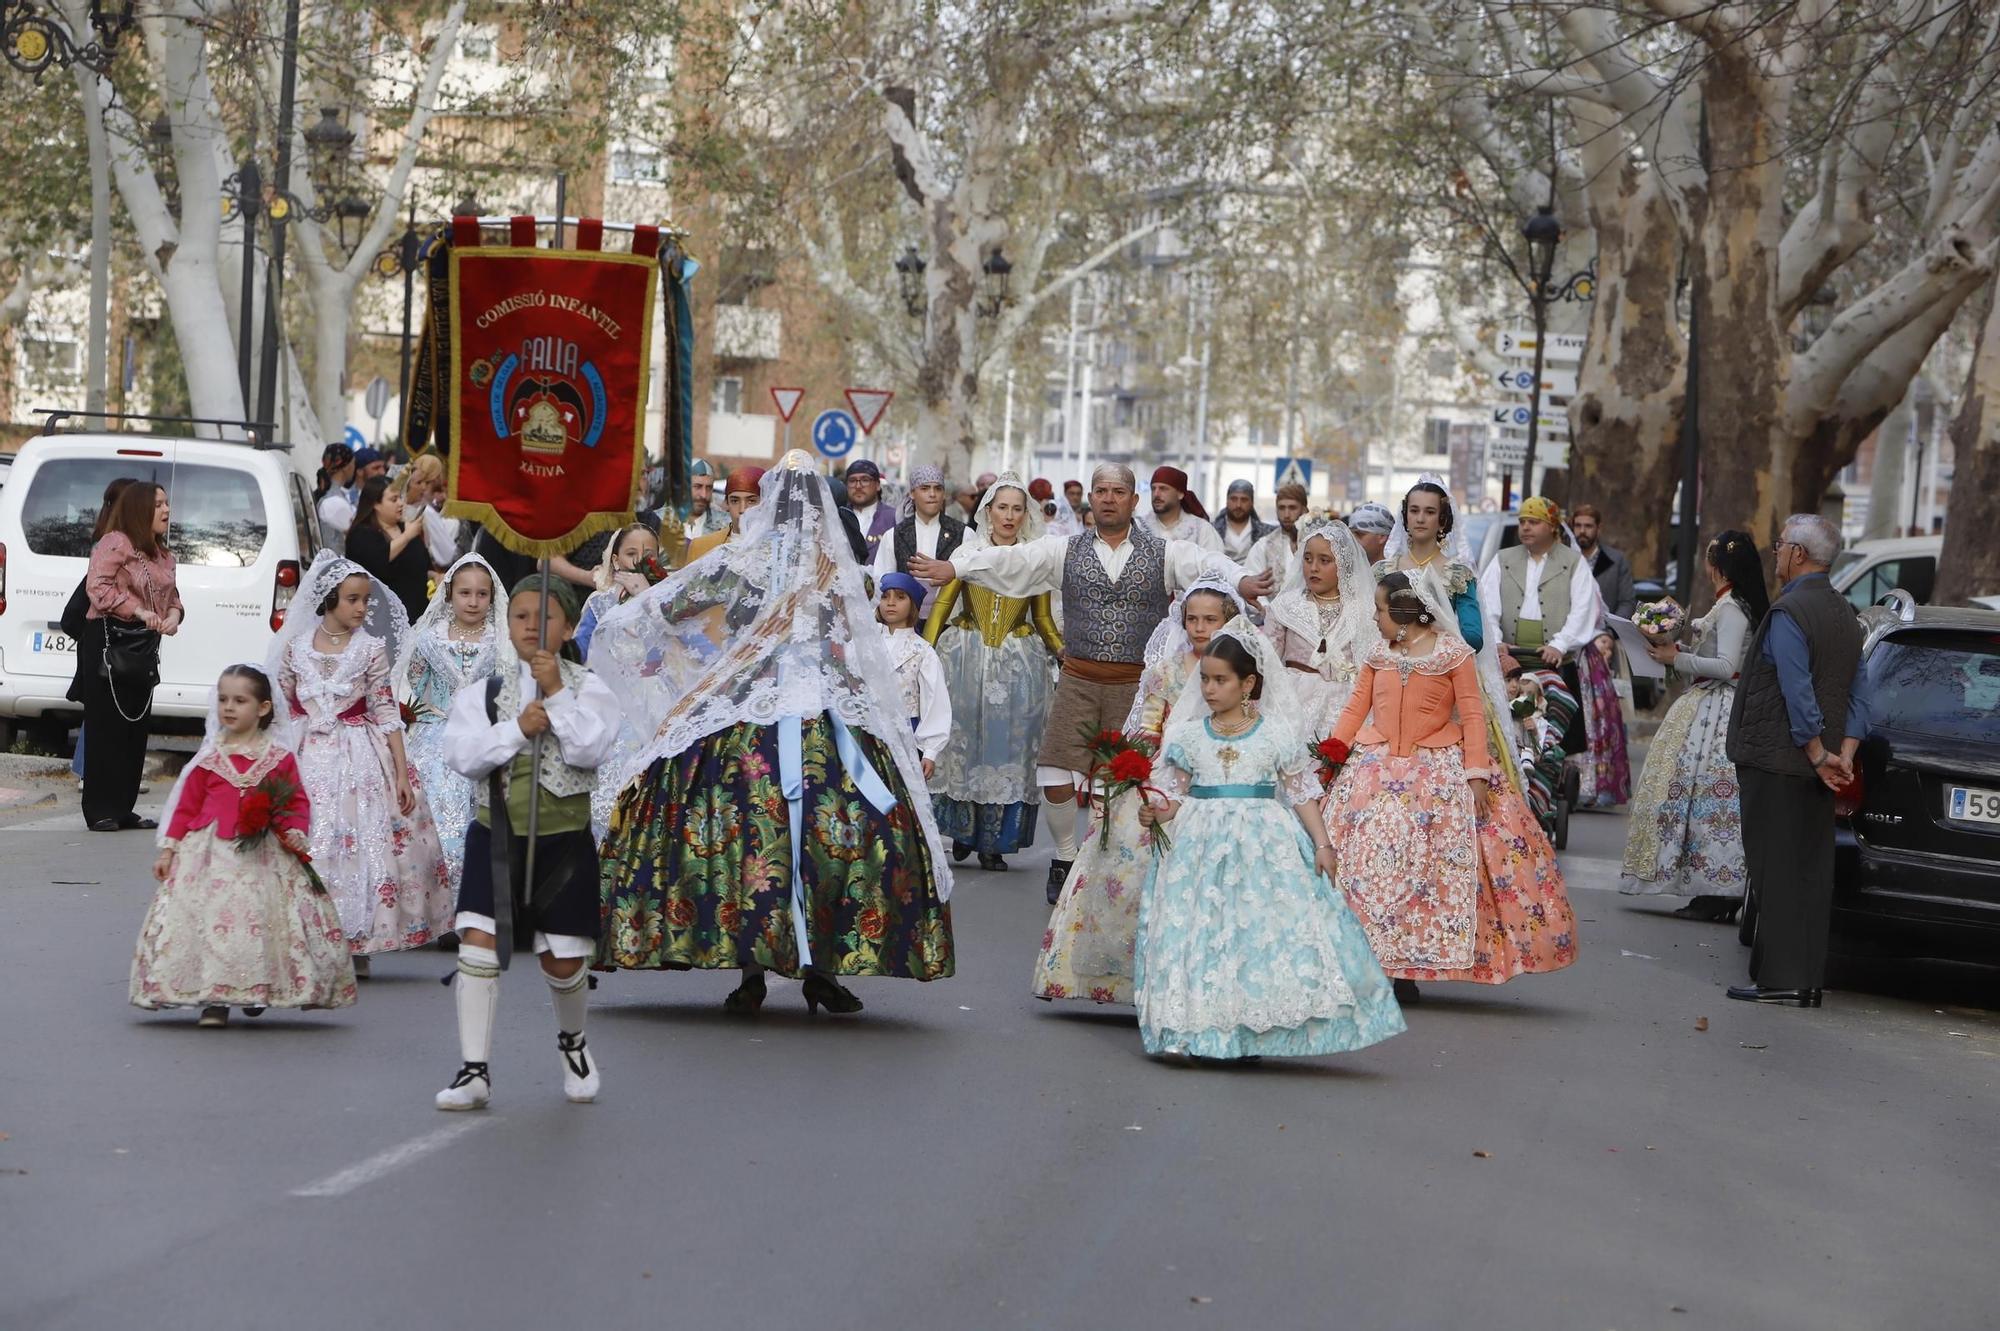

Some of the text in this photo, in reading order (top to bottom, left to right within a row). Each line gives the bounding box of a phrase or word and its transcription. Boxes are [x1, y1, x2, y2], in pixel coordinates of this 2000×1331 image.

[476, 290, 622, 340] COMISSIÓ INFANTIL
[1556, 338, 1585, 348] TAVE
[44, 635, 77, 652] 482
[1969, 794, 2000, 819] 59
